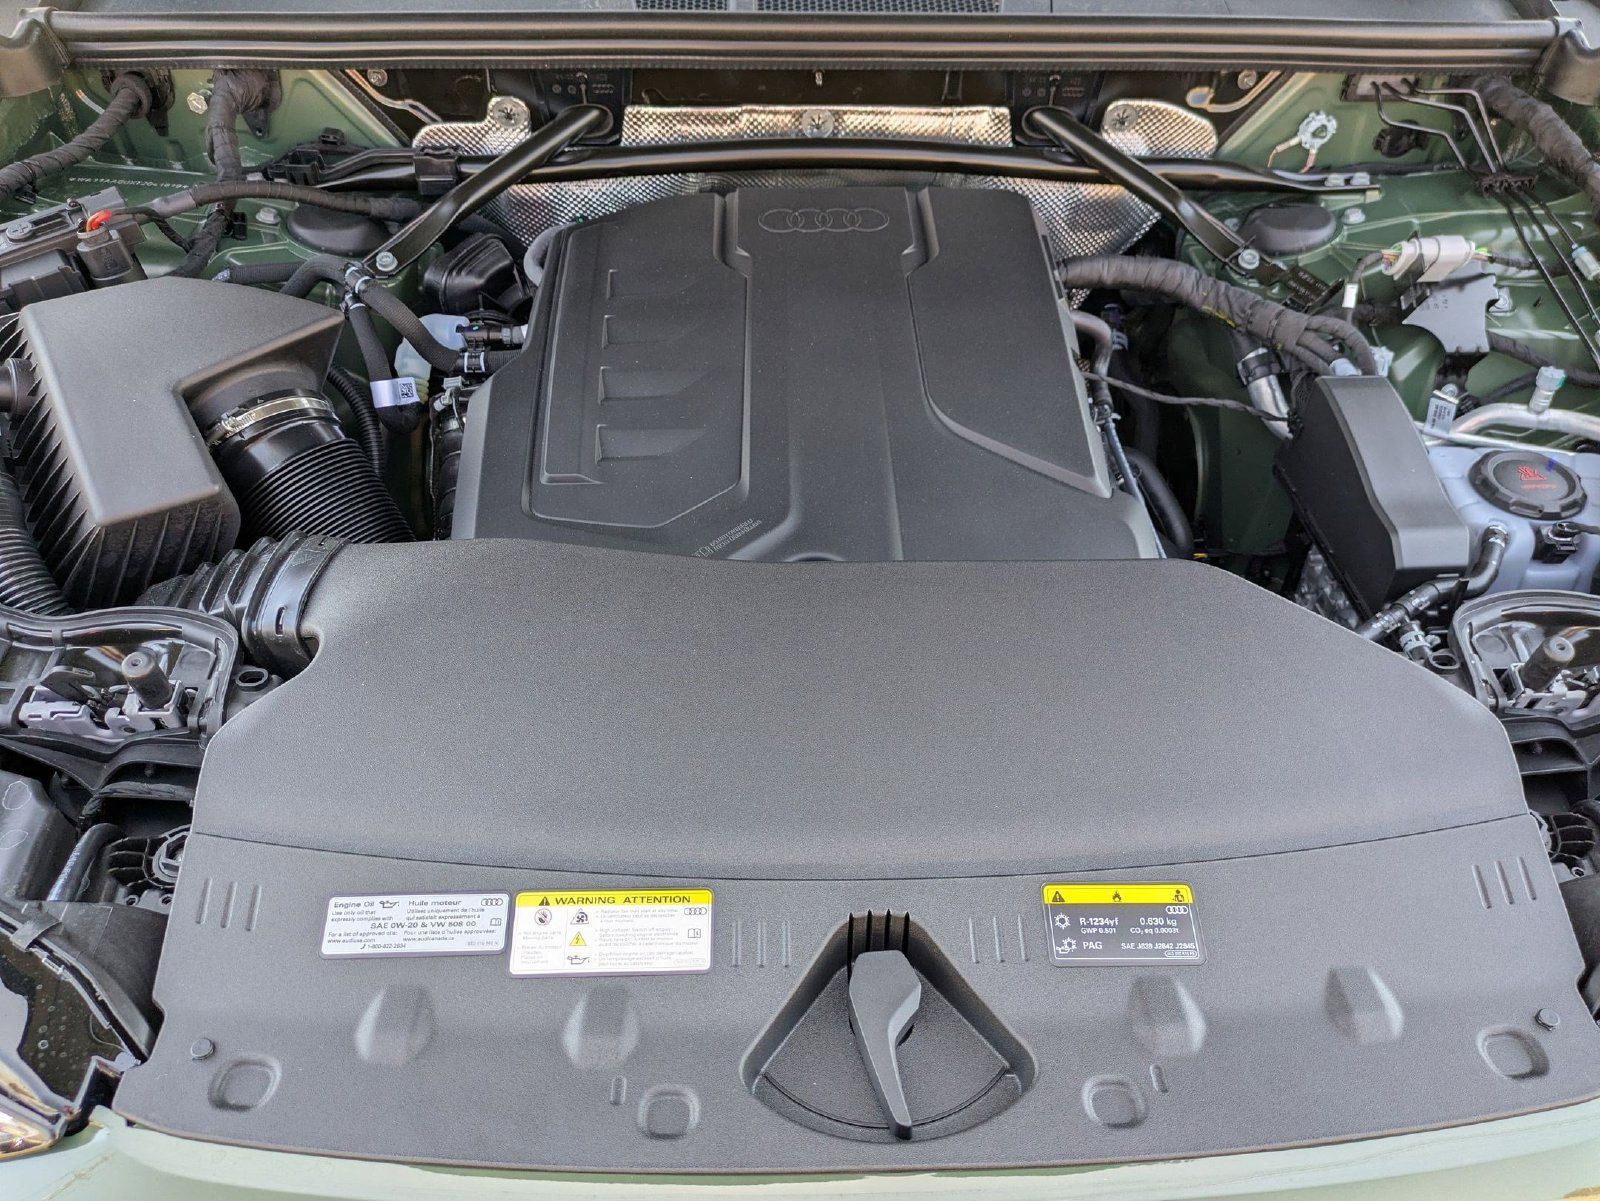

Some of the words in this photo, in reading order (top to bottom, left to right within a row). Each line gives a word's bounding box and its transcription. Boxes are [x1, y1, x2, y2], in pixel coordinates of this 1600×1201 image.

[555, 896, 616, 905] WARNING
[623, 895, 691, 904] ATTENTION
[334, 901, 361, 909] Engine
[390, 921, 419, 929] 0W-20
[1079, 917, 1119, 926] R-1234yf
[1139, 917, 1165, 926] 0.630
[1166, 917, 1177, 926] kg
[1082, 941, 1103, 950] PAG
[1121, 942, 1136, 950] SAE
